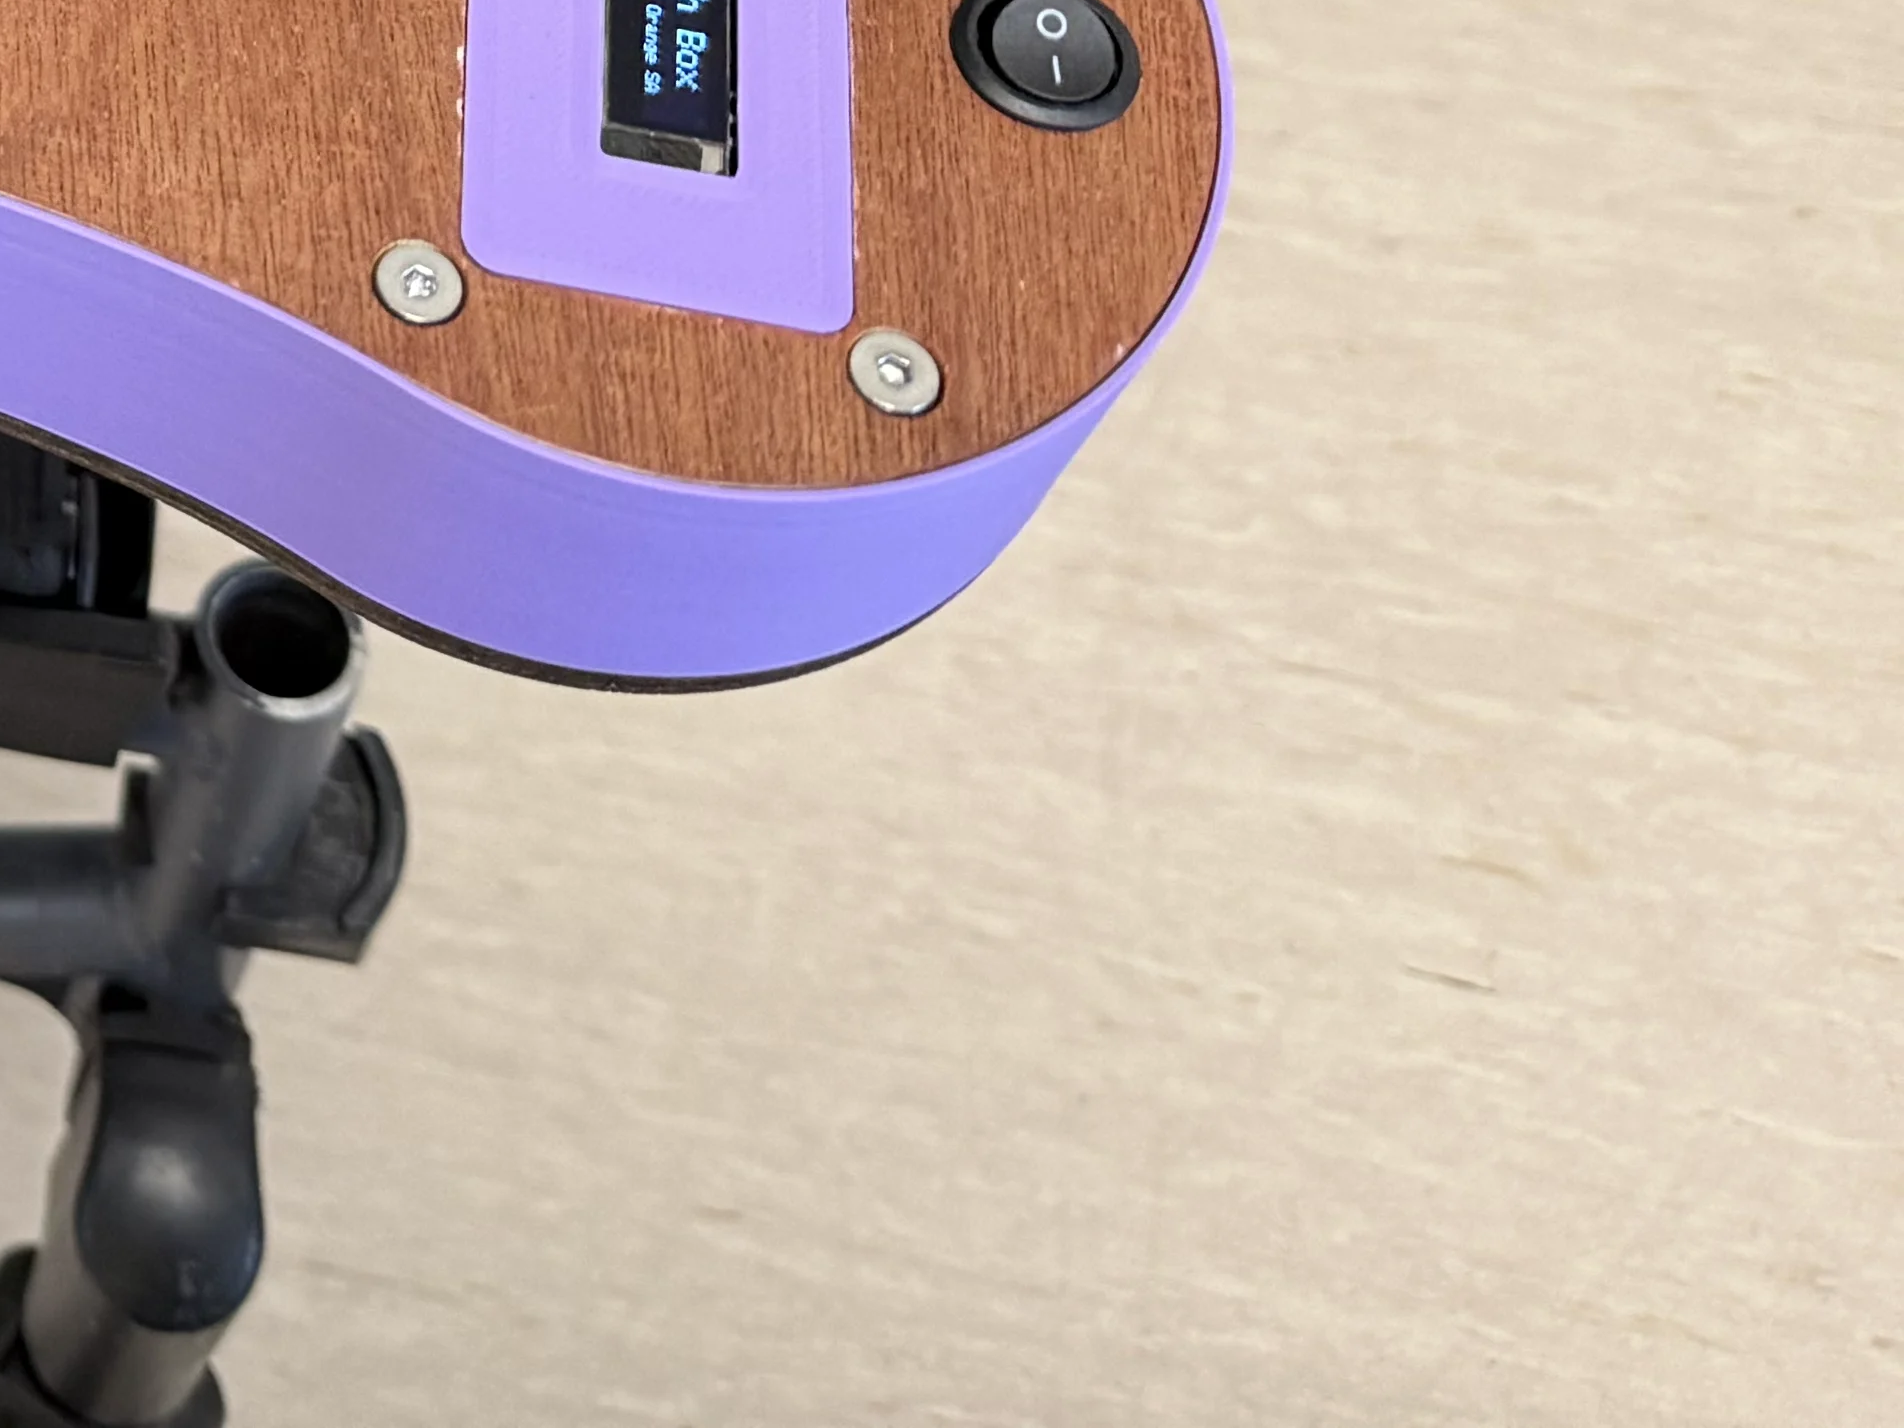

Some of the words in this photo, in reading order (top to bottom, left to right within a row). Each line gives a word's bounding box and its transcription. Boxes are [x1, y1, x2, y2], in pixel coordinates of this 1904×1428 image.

[643, 3, 664, 66] Orange
[675, 28, 709, 93] Box
[643, 69, 662, 96] SA
